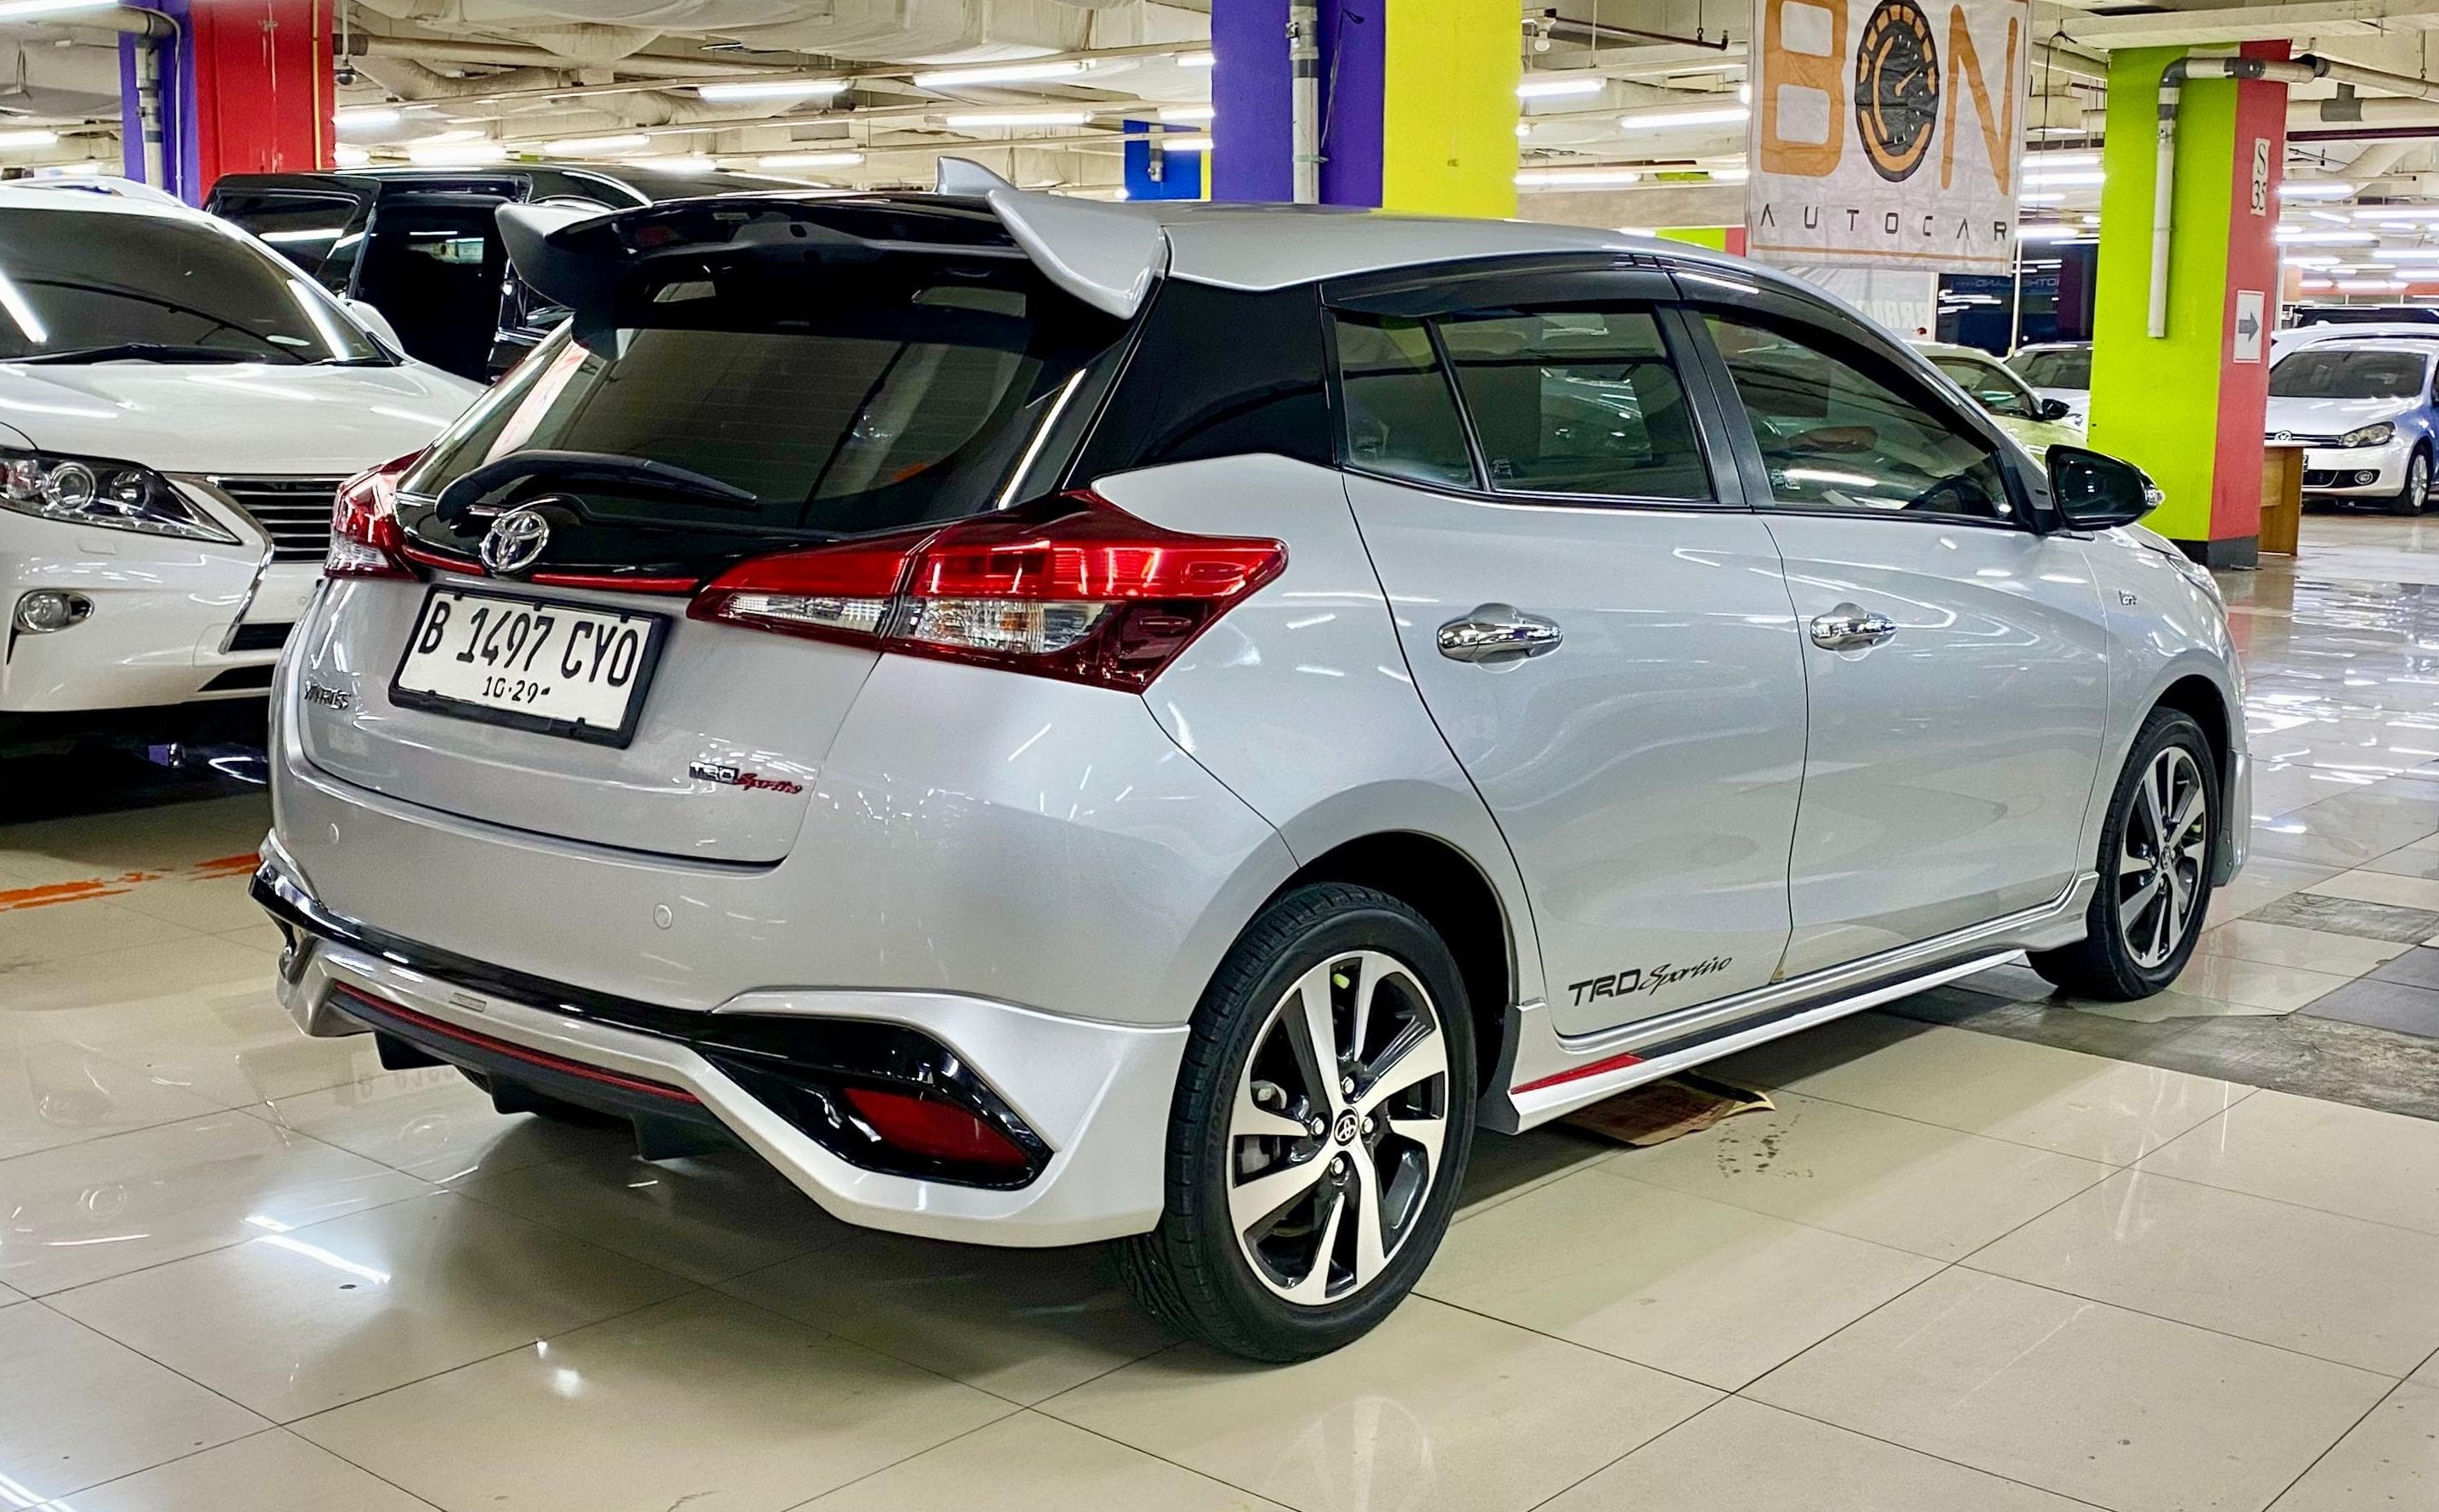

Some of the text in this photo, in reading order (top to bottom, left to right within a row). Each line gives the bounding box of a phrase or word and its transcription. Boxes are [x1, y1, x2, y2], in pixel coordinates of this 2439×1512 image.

[2257, 143, 2266, 175] S
[1760, 204, 2007, 241] AUTOCAR
[418, 601, 638, 687] B 1497 CYO
[1568, 956, 1732, 1007] TRD Sportivo
